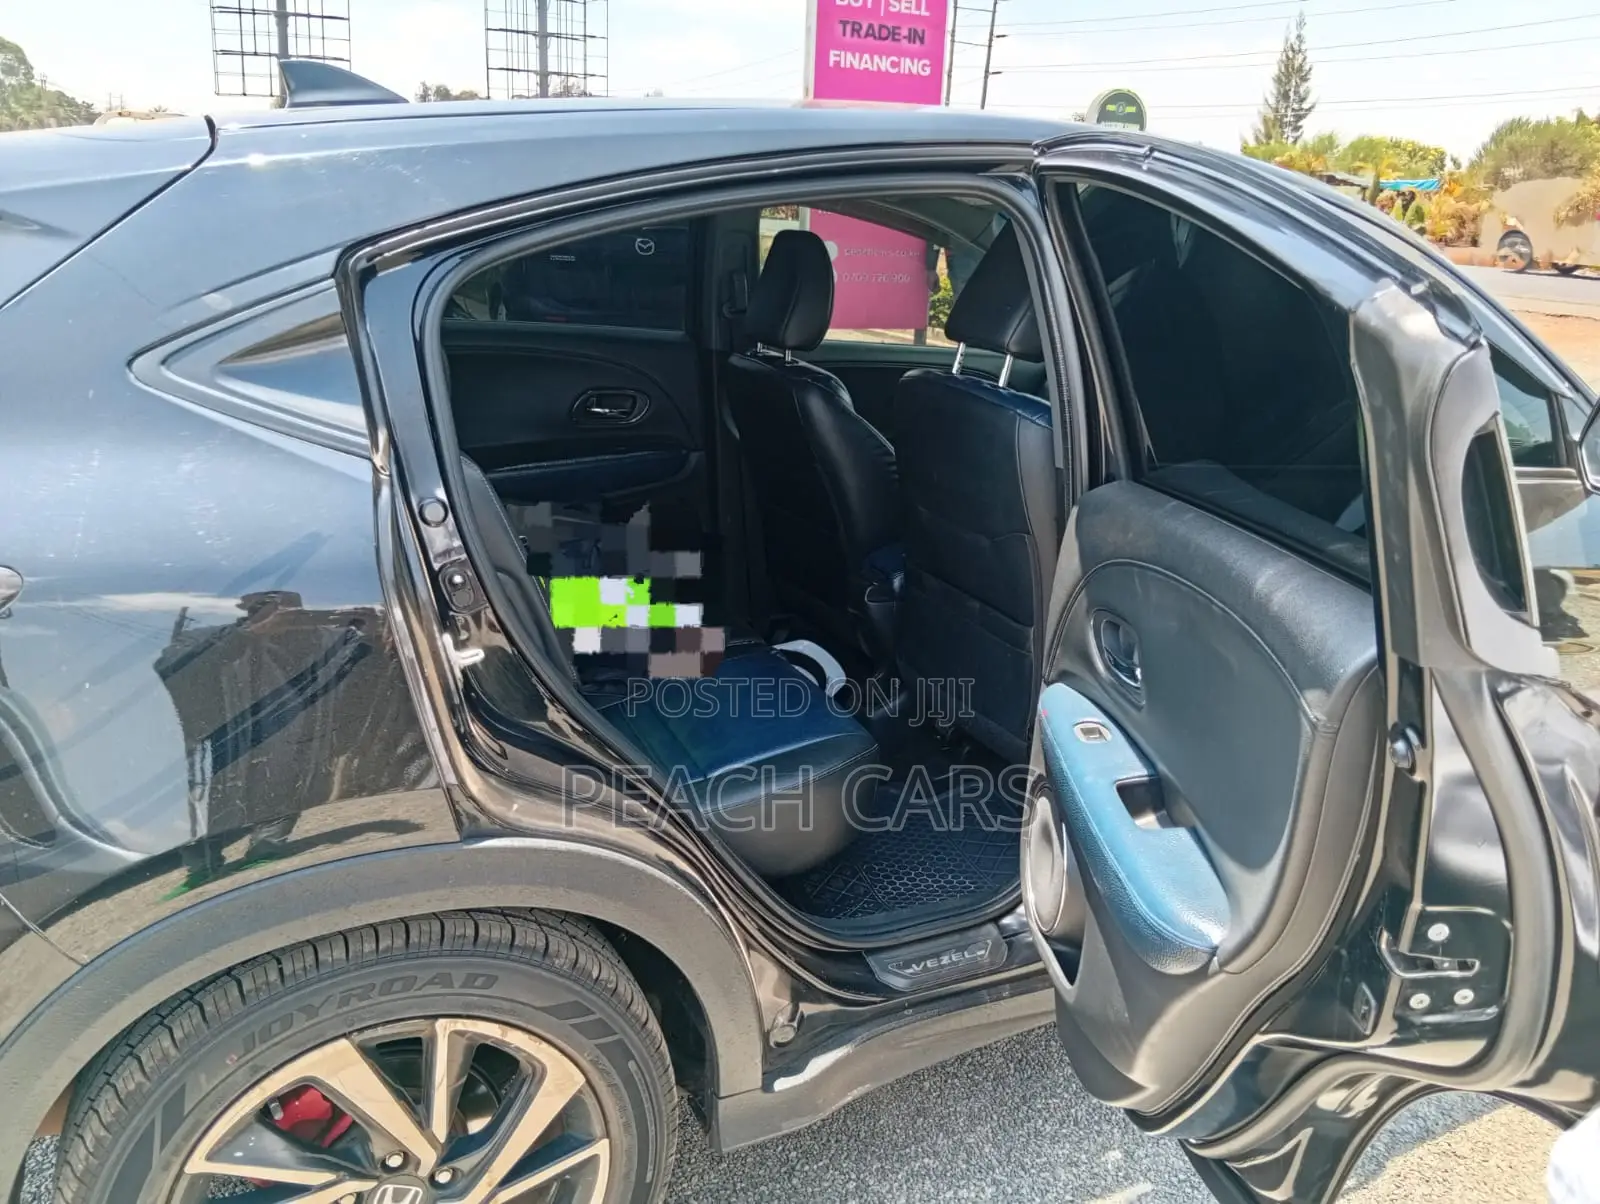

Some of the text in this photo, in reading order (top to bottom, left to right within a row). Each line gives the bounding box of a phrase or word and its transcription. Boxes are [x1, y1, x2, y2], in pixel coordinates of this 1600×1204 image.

[888, 0, 931, 16] SELL
[838, 20, 926, 45] TRADE-IN
[828, 49, 931, 77] FINANCING
[911, 950, 977, 971] VEZEL
[232, 972, 499, 1056] JOYROAD
